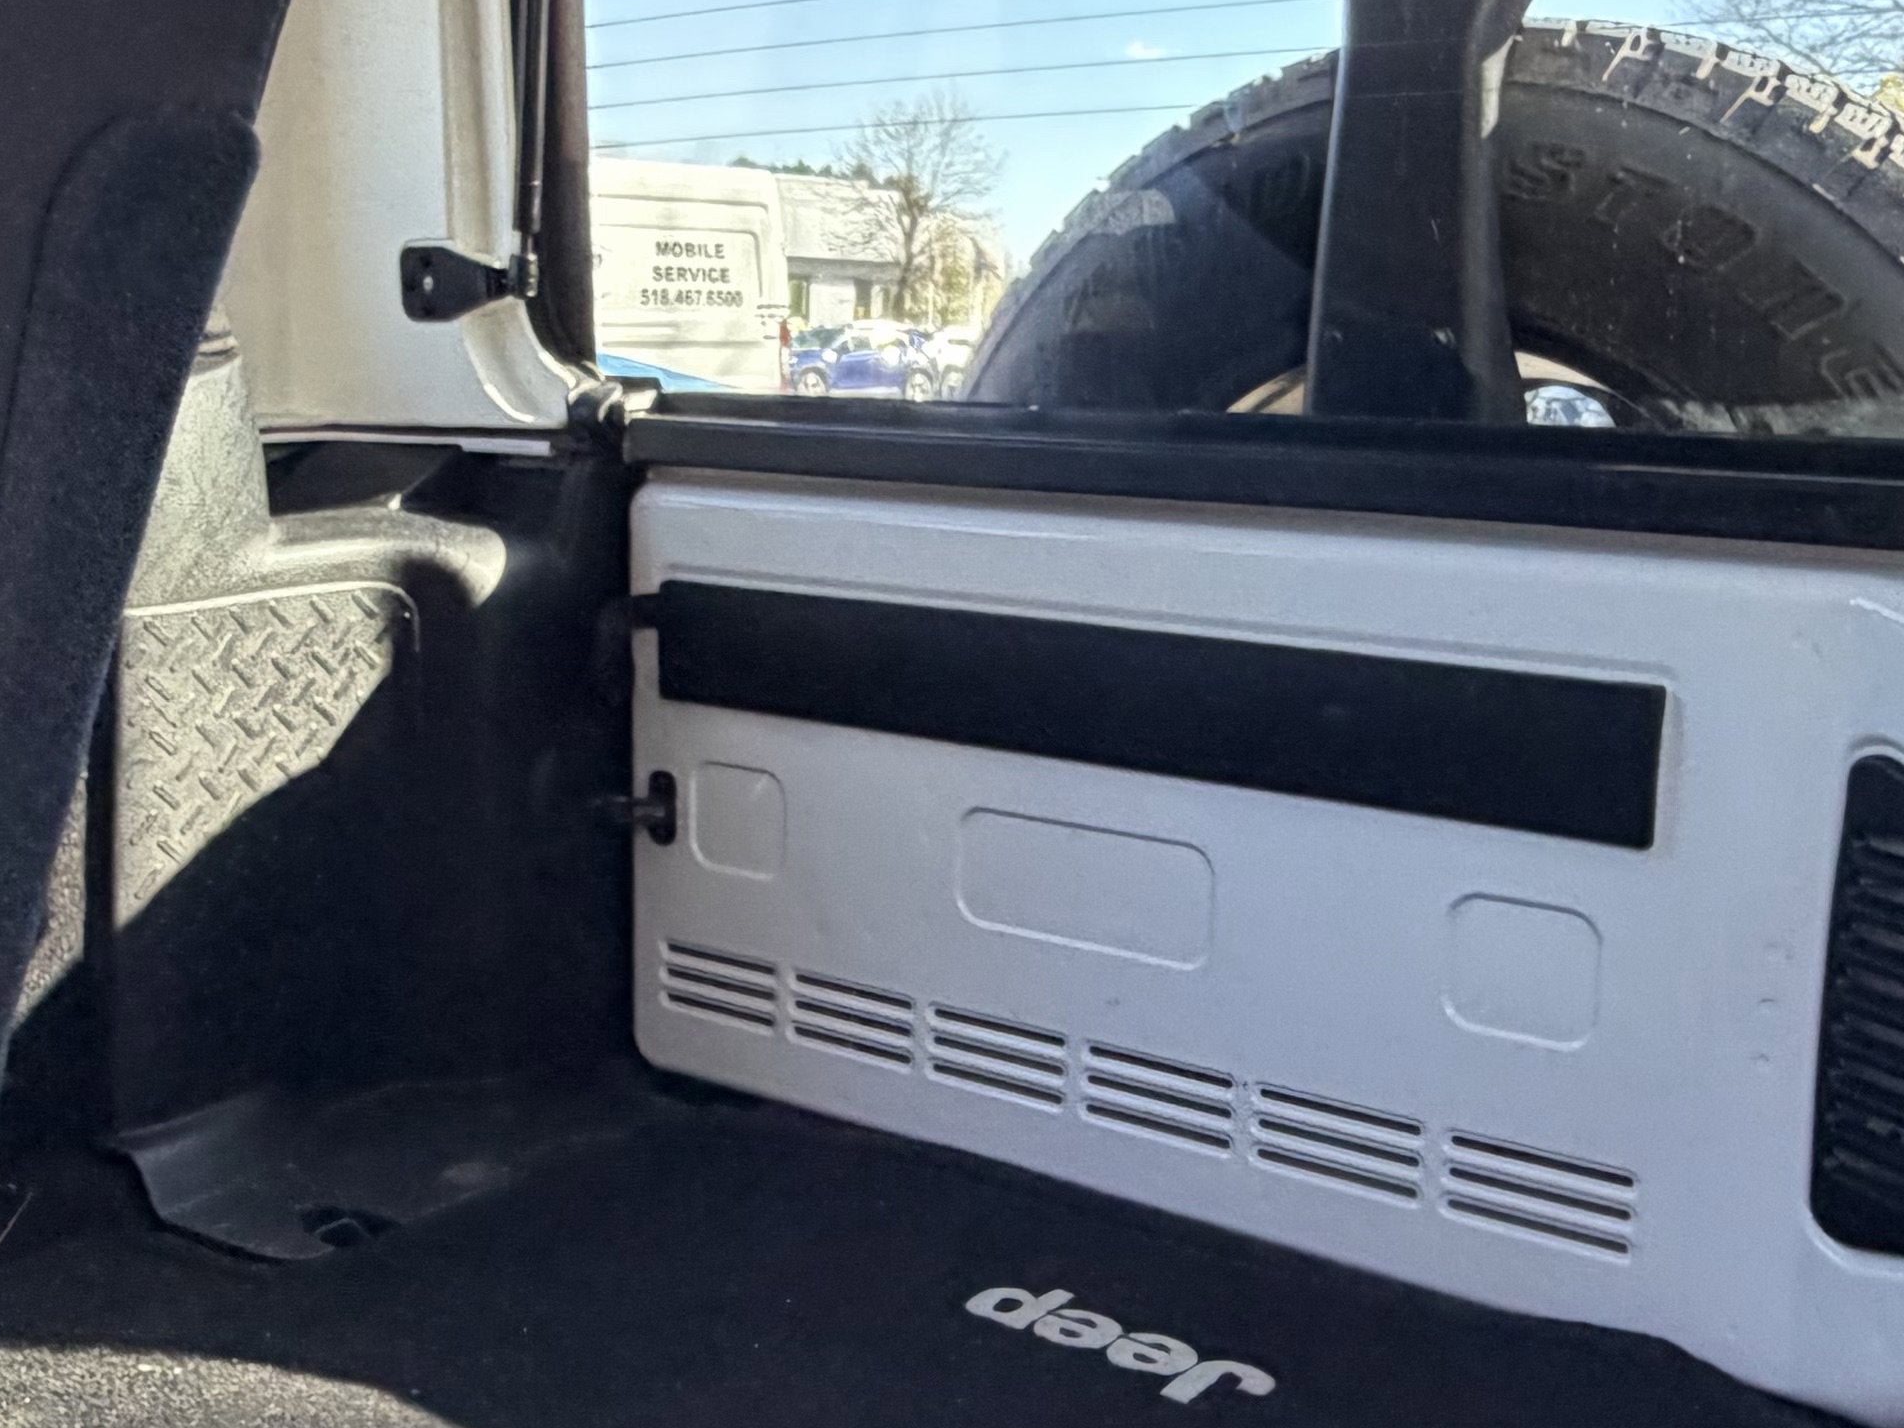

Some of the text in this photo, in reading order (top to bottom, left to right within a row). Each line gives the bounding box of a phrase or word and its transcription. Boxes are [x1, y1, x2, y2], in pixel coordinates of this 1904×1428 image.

[655, 241, 725, 259] MOBILE
[652, 265, 731, 284] SERVICE
[964, 1286, 1277, 1404] Jeep
